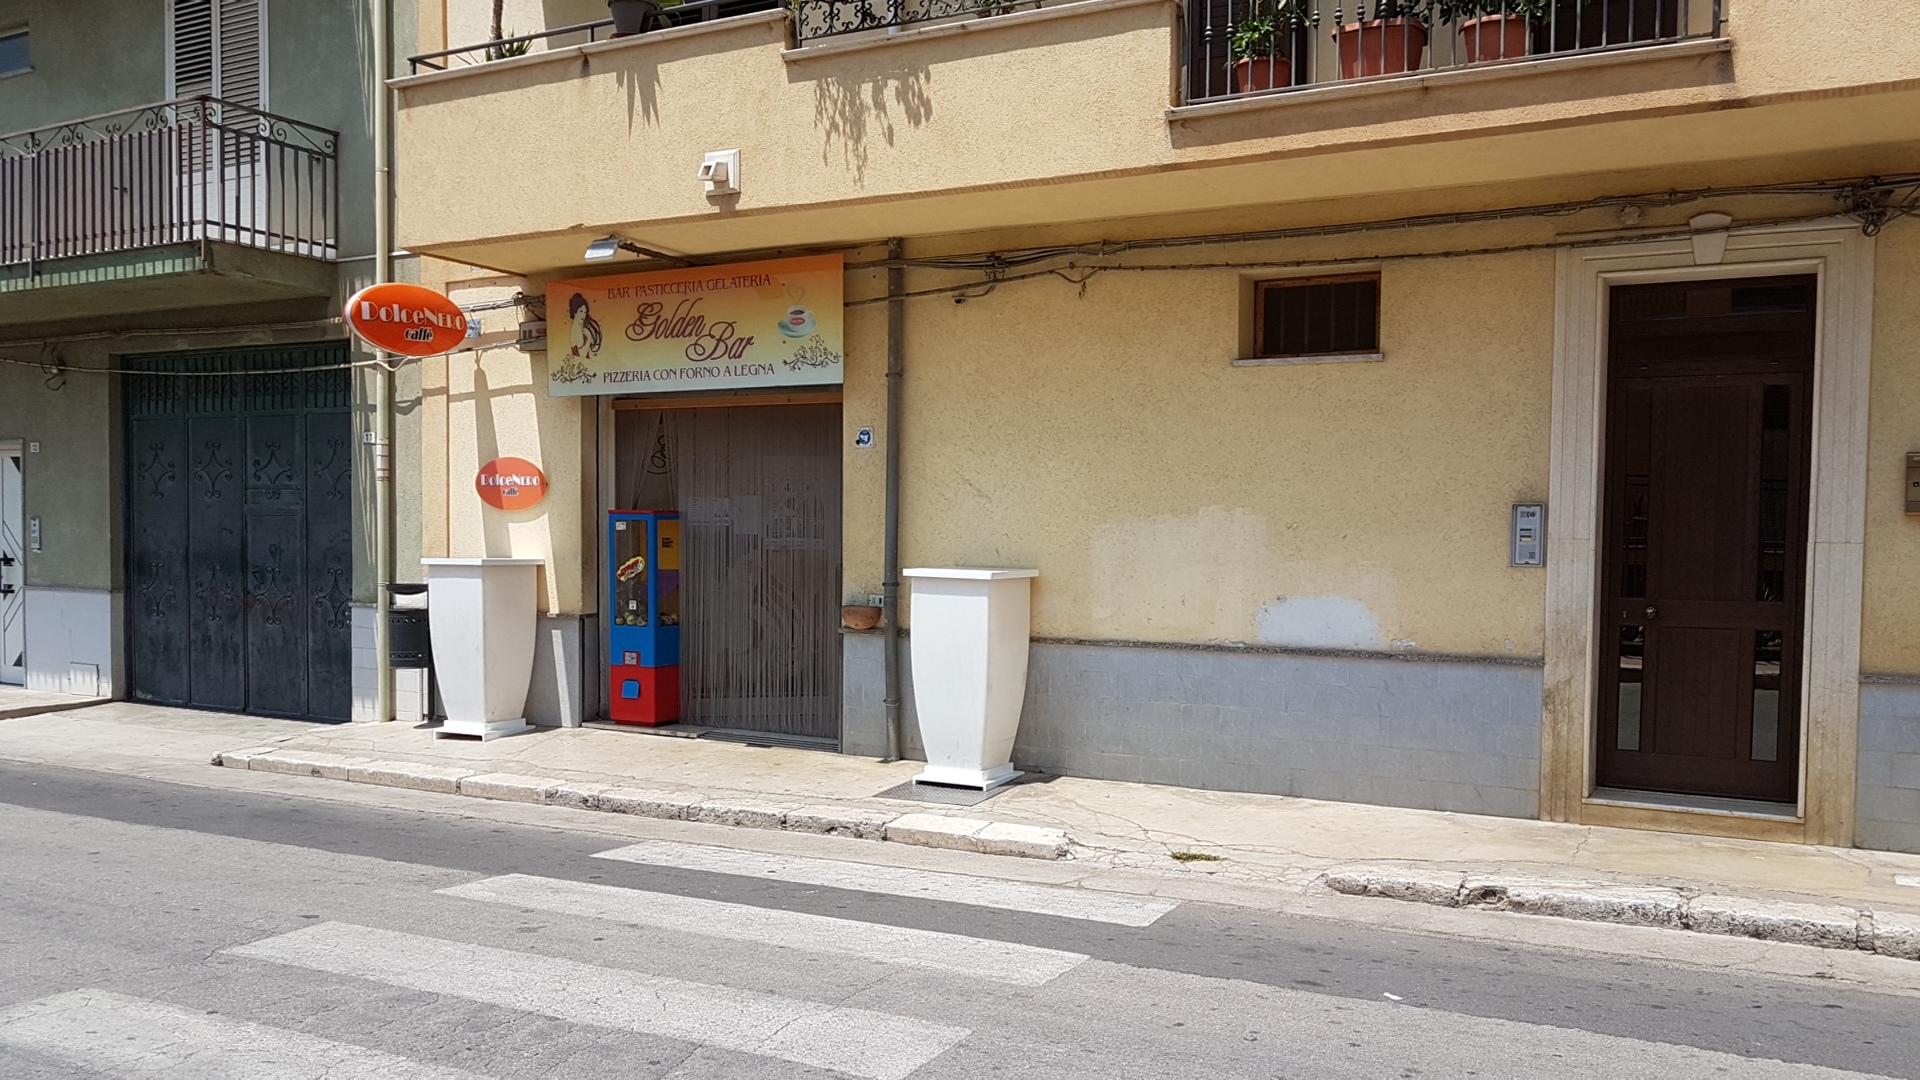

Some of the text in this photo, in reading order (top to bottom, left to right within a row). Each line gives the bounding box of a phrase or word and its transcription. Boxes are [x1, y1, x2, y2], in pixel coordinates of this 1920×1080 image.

[607, 273, 772, 300] BAR PASTICCERIA GELATERIA
[624, 297, 708, 342] Golden
[404, 326, 434, 342] caffè
[685, 320, 755, 362] Bar
[603, 362, 776, 384] PIZZERIA CON FORNO A LEGNA
